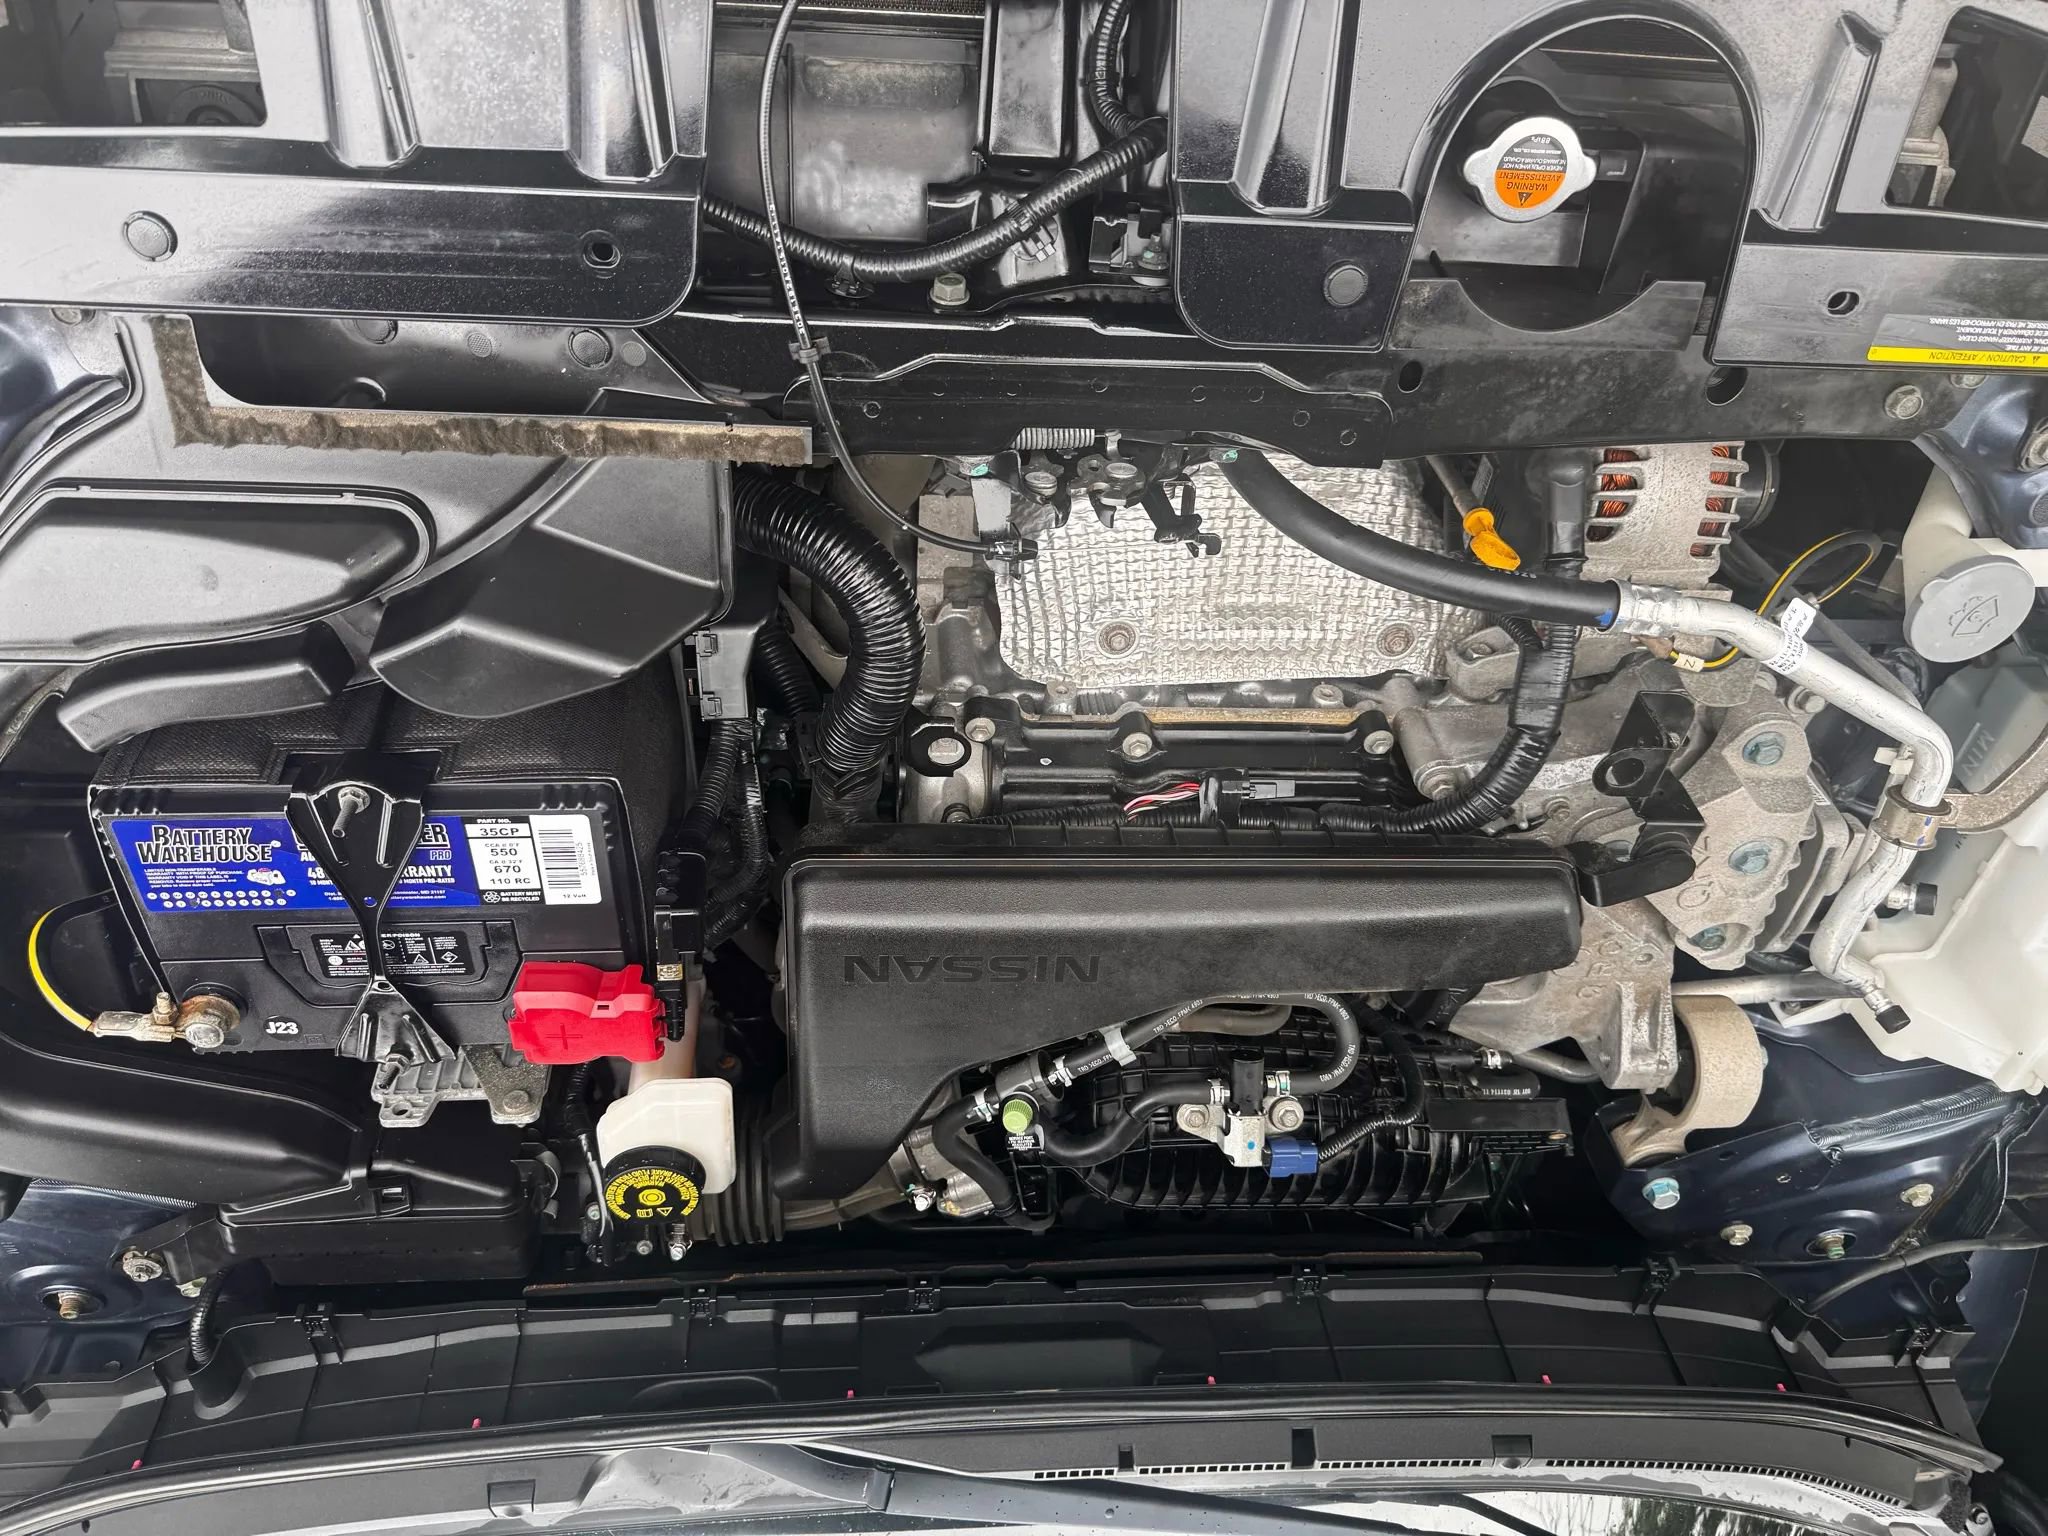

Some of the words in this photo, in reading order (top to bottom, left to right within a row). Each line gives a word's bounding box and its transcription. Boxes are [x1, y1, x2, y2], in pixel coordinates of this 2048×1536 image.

[1498, 172, 1562, 182] AVERTISSEMENT
[1506, 181, 1549, 192] WARNING
[1929, 352, 1978, 362] ATTENTION
[1987, 354, 2026, 363] CAUTION
[1962, 729, 1996, 776] MIN
[151, 825, 252, 847] BATTERY
[480, 828, 520, 836] 35CP
[136, 842, 273, 864] WAREHOUSE
[430, 850, 452, 860] PRO
[307, 867, 325, 879] 48
[843, 954, 1100, 984] NISSAN
[266, 1020, 299, 1035] J23
